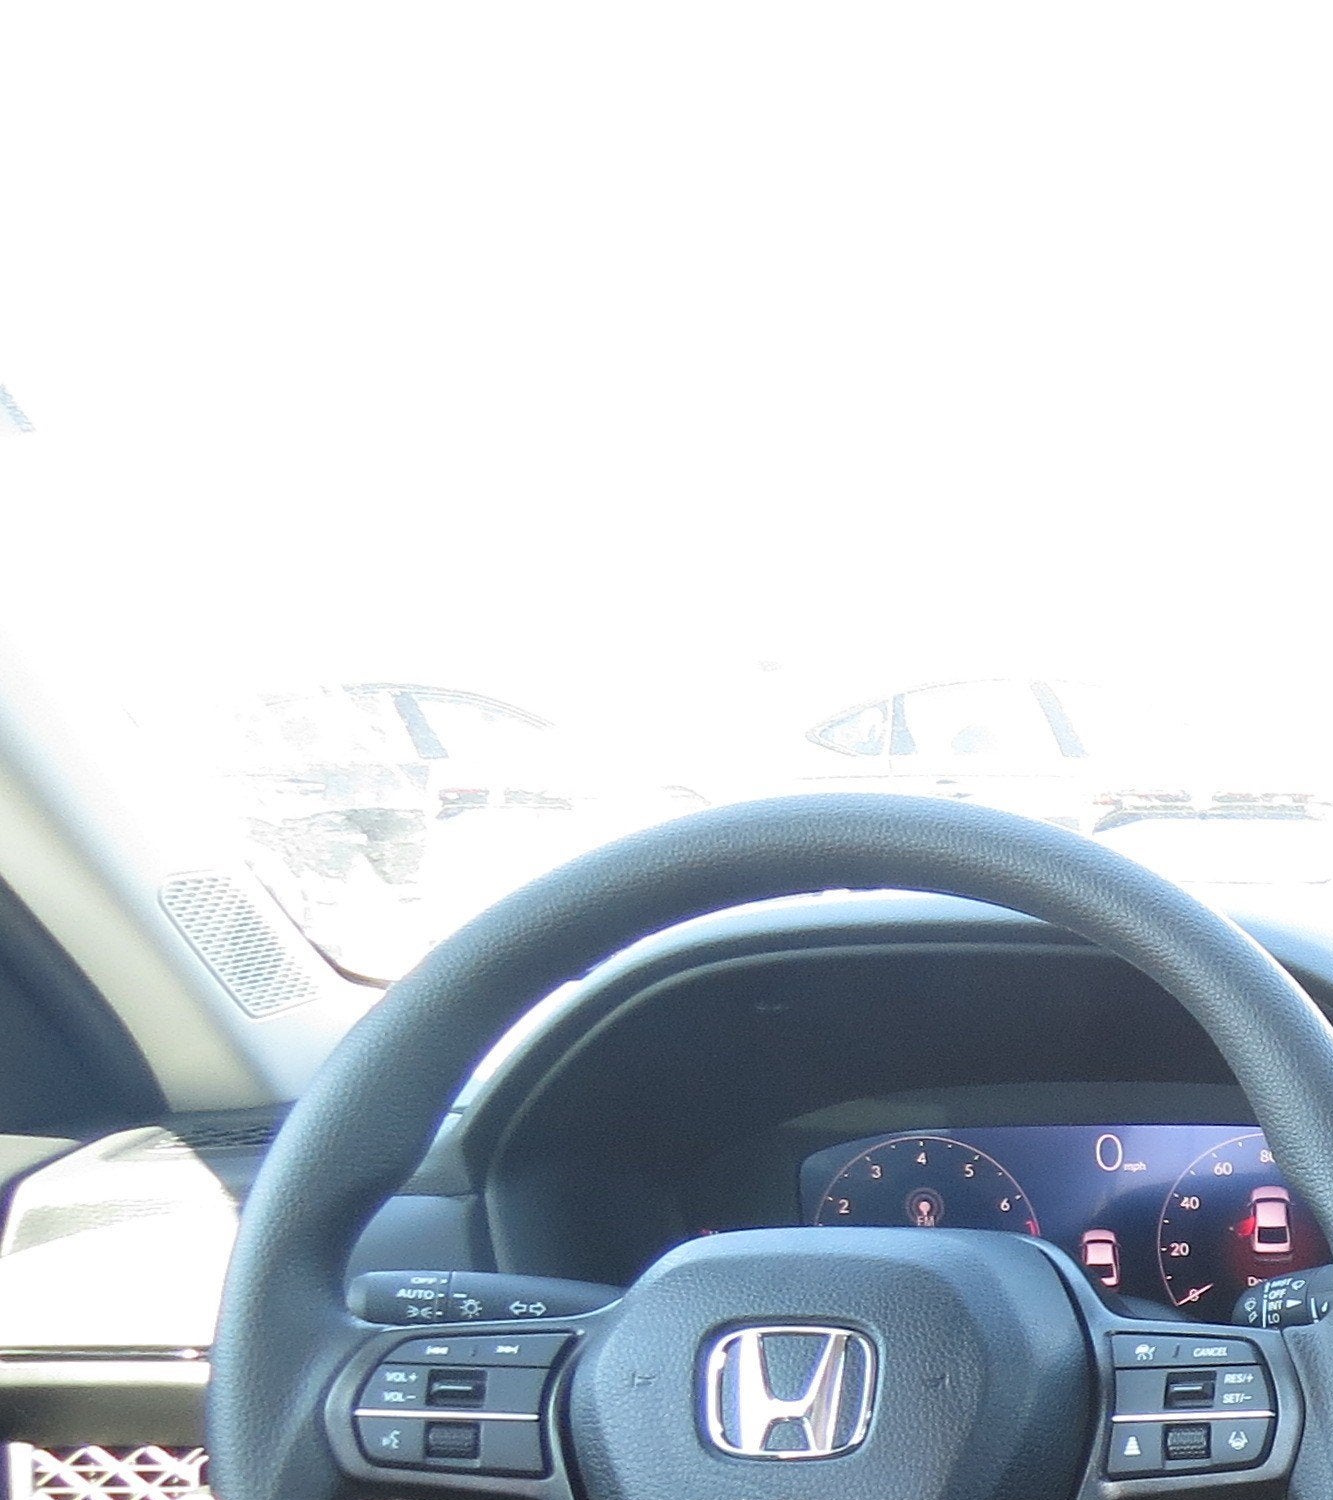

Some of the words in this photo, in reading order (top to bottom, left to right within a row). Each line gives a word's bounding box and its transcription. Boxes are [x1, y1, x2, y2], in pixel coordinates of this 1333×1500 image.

[917, 1152, 927, 1165] 4
[1096, 1133, 1123, 1171] 0
[871, 1165, 882, 1179] 3
[964, 1164, 975, 1178] 5
[1213, 1162, 1233, 1176] 60
[838, 1199, 850, 1214] 2
[1000, 1199, 1011, 1211] 6
[1179, 1196, 1200, 1210] 40
[1169, 1242, 1190, 1256] 20
[396, 1288, 435, 1300] AUTO
[1267, 1312, 1280, 1324] LO
[1193, 1346, 1228, 1358] CANCEL
